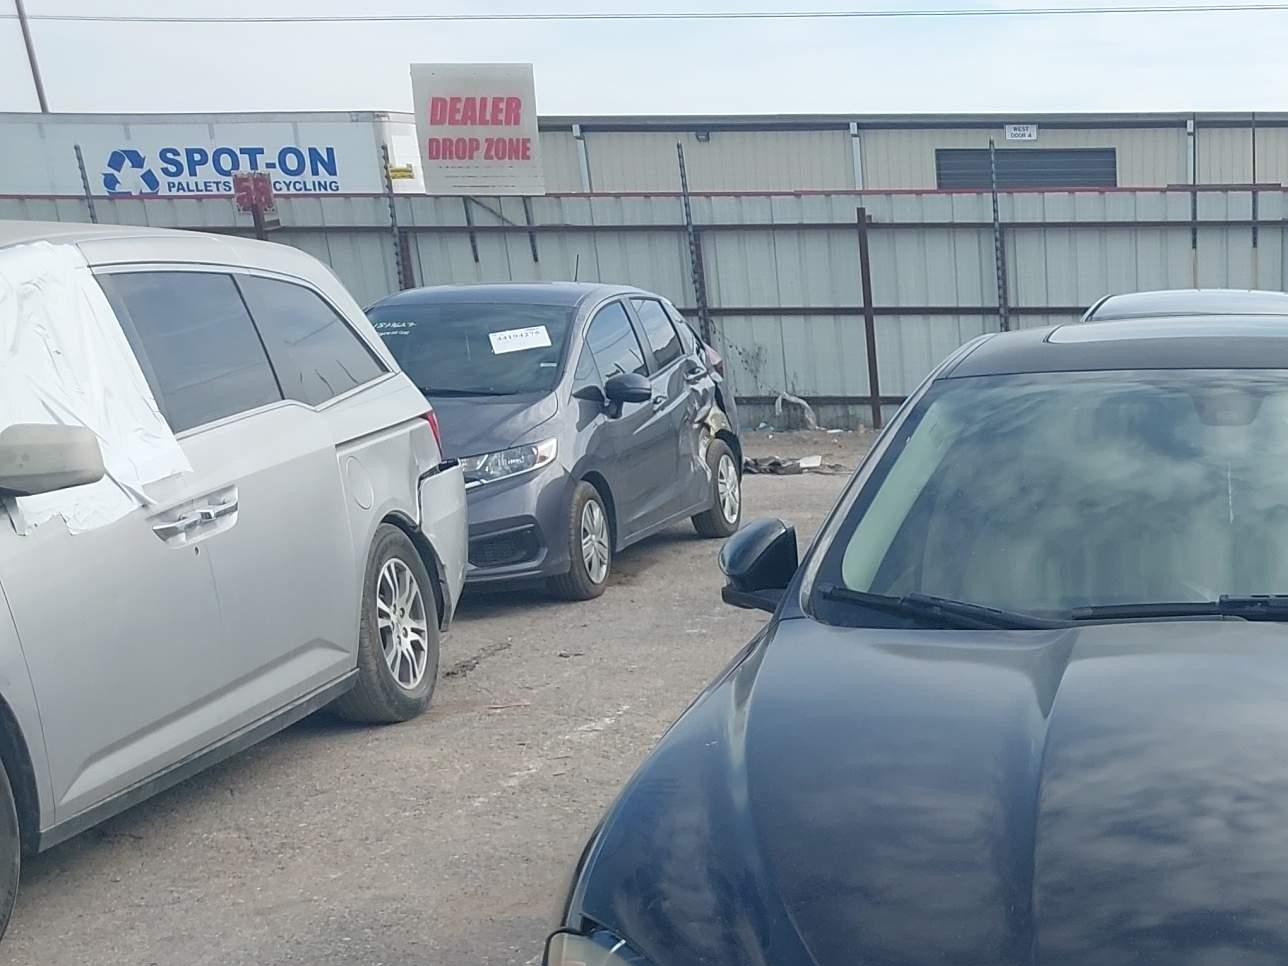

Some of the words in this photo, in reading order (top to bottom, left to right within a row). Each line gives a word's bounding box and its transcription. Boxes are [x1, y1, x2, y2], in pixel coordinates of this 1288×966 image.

[430, 96, 522, 126] DEALER
[159, 147, 338, 177] SPOT-ON
[428, 137, 480, 161] DROP
[483, 137, 531, 161] ZONE
[167, 180, 232, 193] PALLETS
[272, 180, 340, 192] CYCLING
